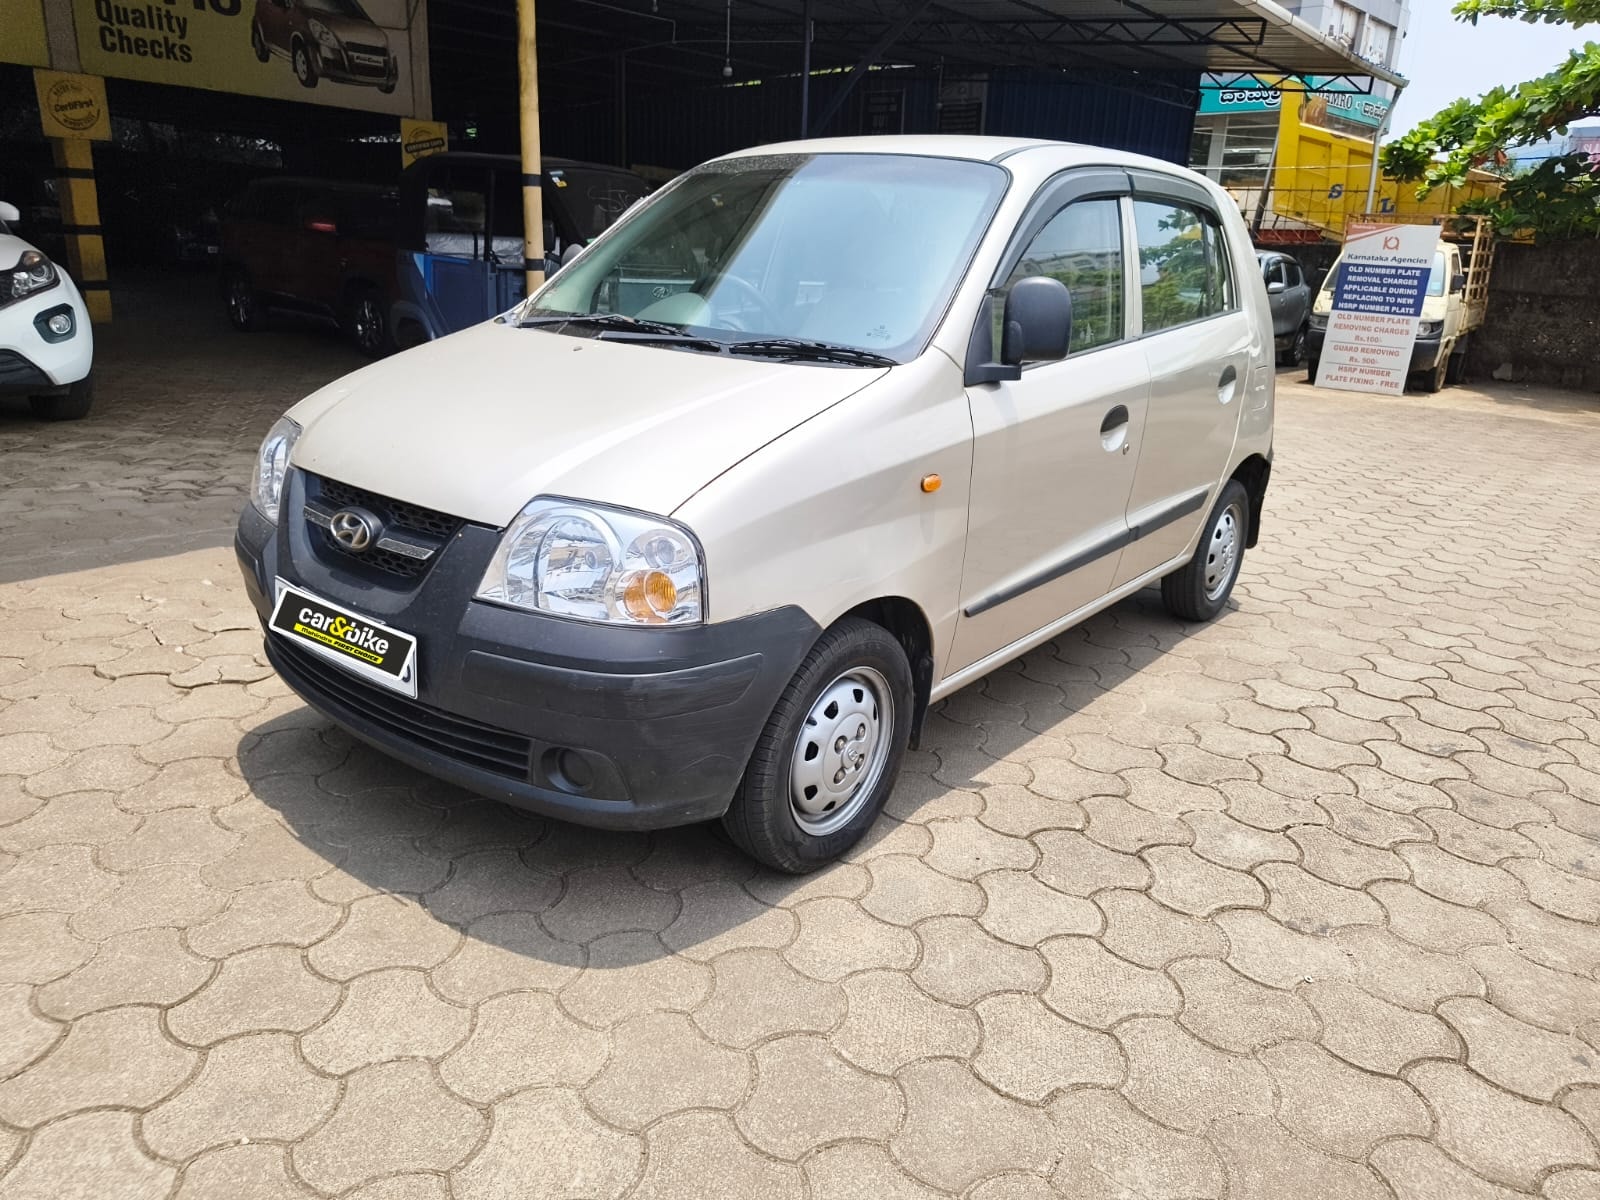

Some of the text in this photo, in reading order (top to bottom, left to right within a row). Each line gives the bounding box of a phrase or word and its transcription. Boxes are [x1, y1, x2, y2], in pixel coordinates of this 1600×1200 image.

[95, 0, 187, 39] Quality
[99, 25, 193, 63] Checks
[1328, 184, 1344, 199] S
[1347, 253, 1428, 264] Karnataka Agencies
[1364, 267, 1396, 275] NUMBER
[1347, 275, 1418, 286] REMOVAL CHARGES
[1343, 284, 1418, 295] APPLICABLE DURING
[1343, 293, 1384, 302] REPLACING
[1359, 303, 1390, 312] NUMBER
[1391, 306, 1415, 314] PLATE
[1353, 314, 1385, 323] NUMBER
[1386, 317, 1411, 325] PLATE
[1333, 323, 1410, 336] REMOVING CHARGES
[1333, 344, 1400, 357] GUARD REMOVING
[1338, 366, 1391, 377] HSRP NUMBER
[1325, 374, 1348, 382] PLATE
[1349, 377, 1374, 386] FIXING
